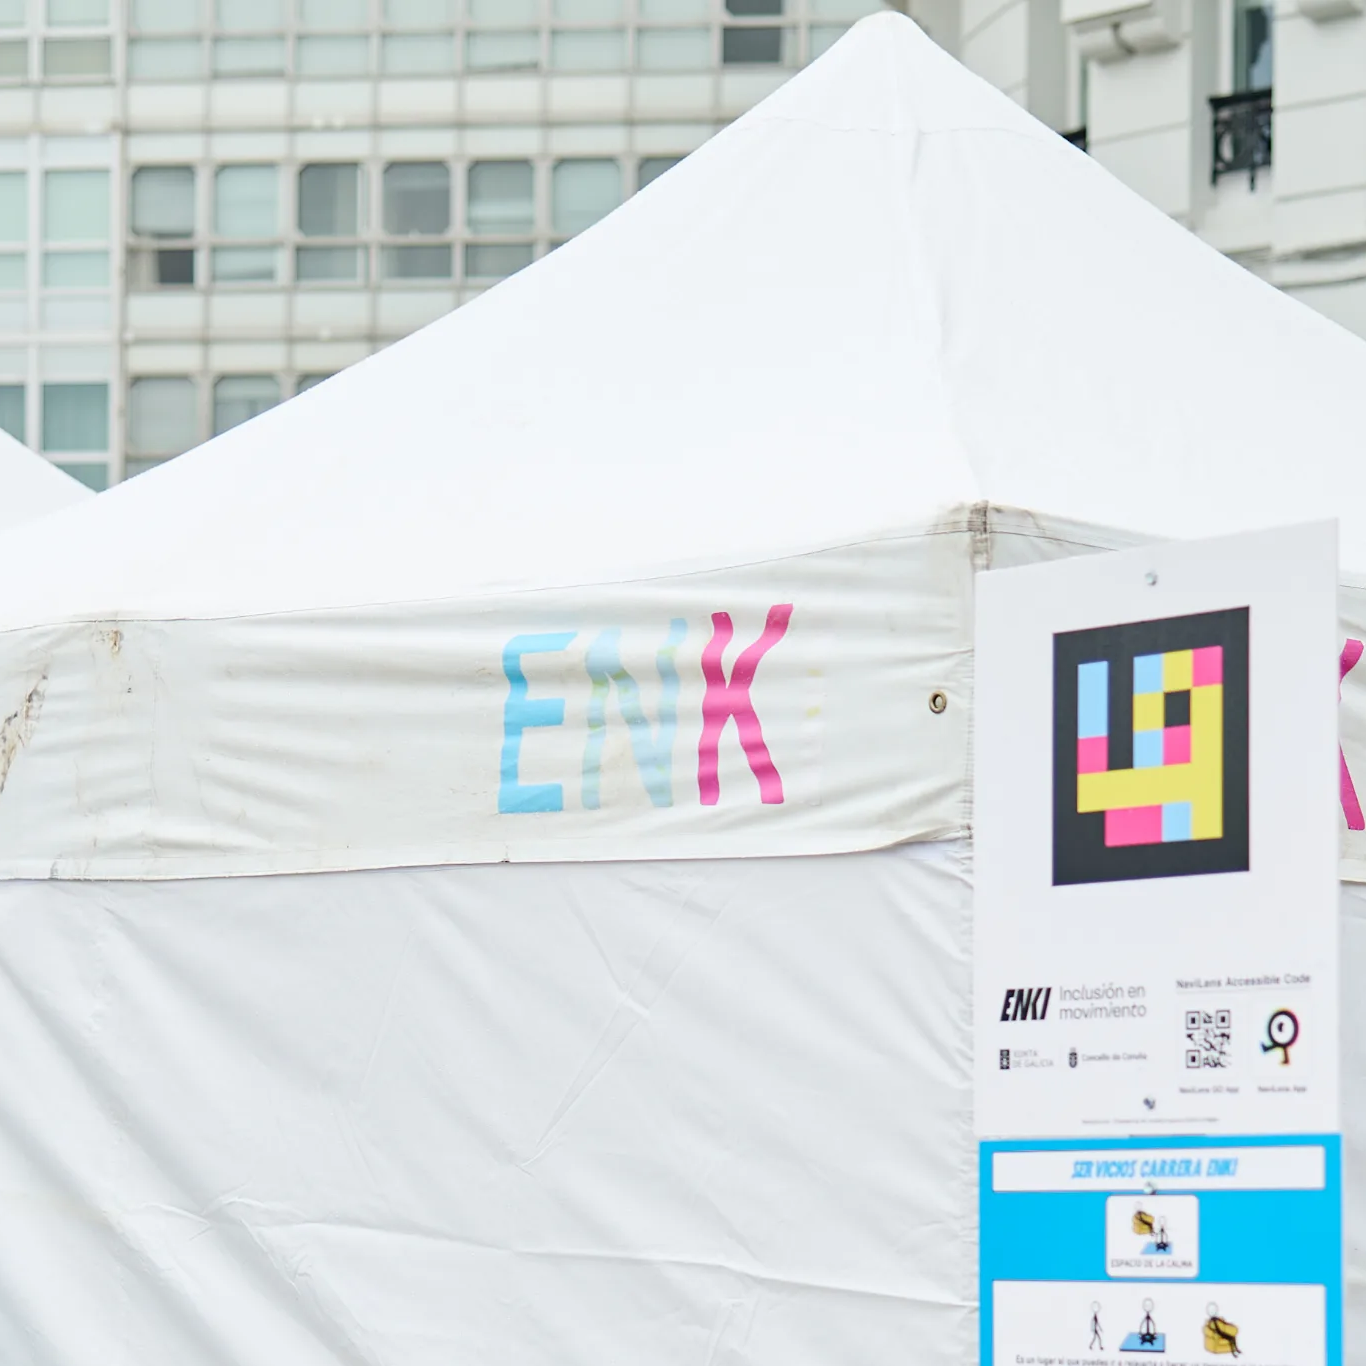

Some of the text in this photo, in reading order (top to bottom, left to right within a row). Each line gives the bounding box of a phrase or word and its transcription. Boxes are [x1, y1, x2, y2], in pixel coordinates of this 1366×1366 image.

[1059, 983, 1146, 1001] Inclusión en
[1000, 987, 1053, 1022] ENKI
[1059, 1002, 1147, 1020] movimiento
[1140, 1158, 1202, 1178] CARRERA
